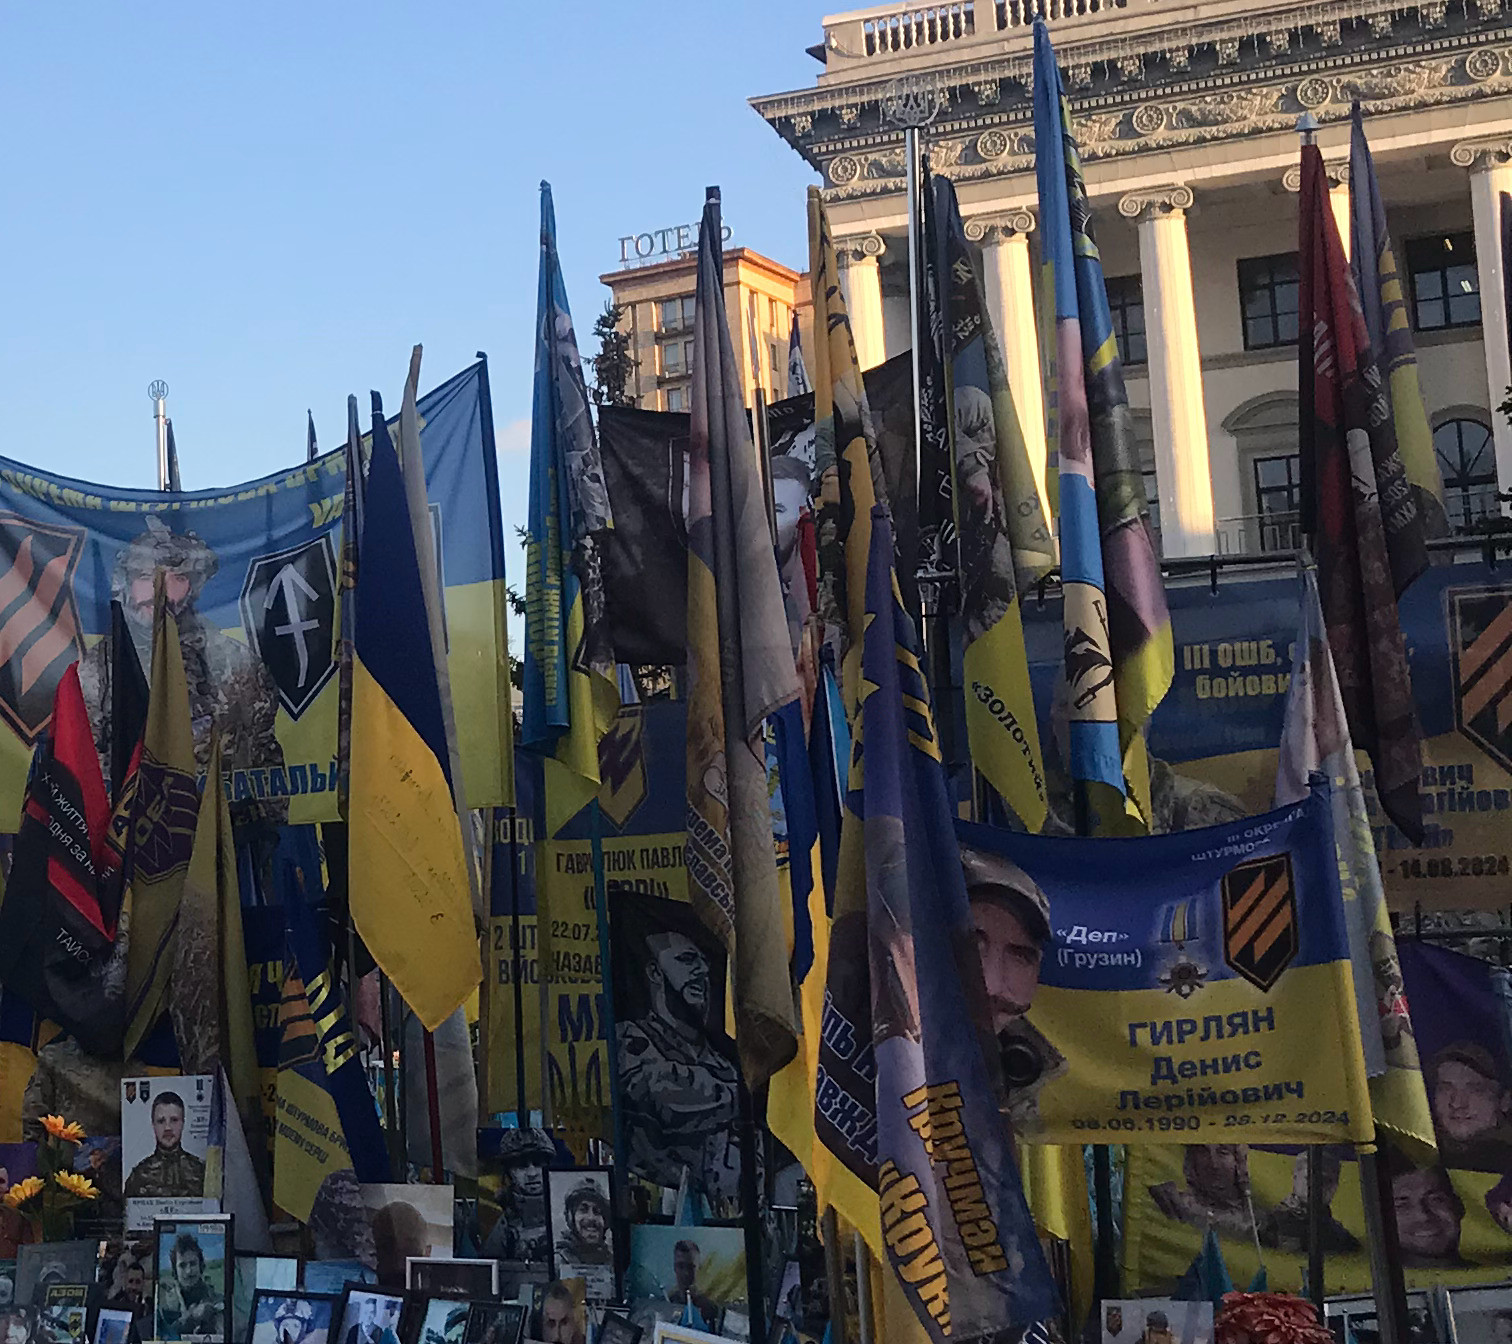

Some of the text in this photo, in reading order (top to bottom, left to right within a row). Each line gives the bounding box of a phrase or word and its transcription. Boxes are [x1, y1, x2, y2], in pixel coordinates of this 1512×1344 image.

[1056, 923, 1130, 947] «Деп»
[1057, 947, 1143, 969] (Грузин)
[1128, 1004, 1276, 1049] ГИРЛЯН
[1150, 1048, 1264, 1087] Денис
